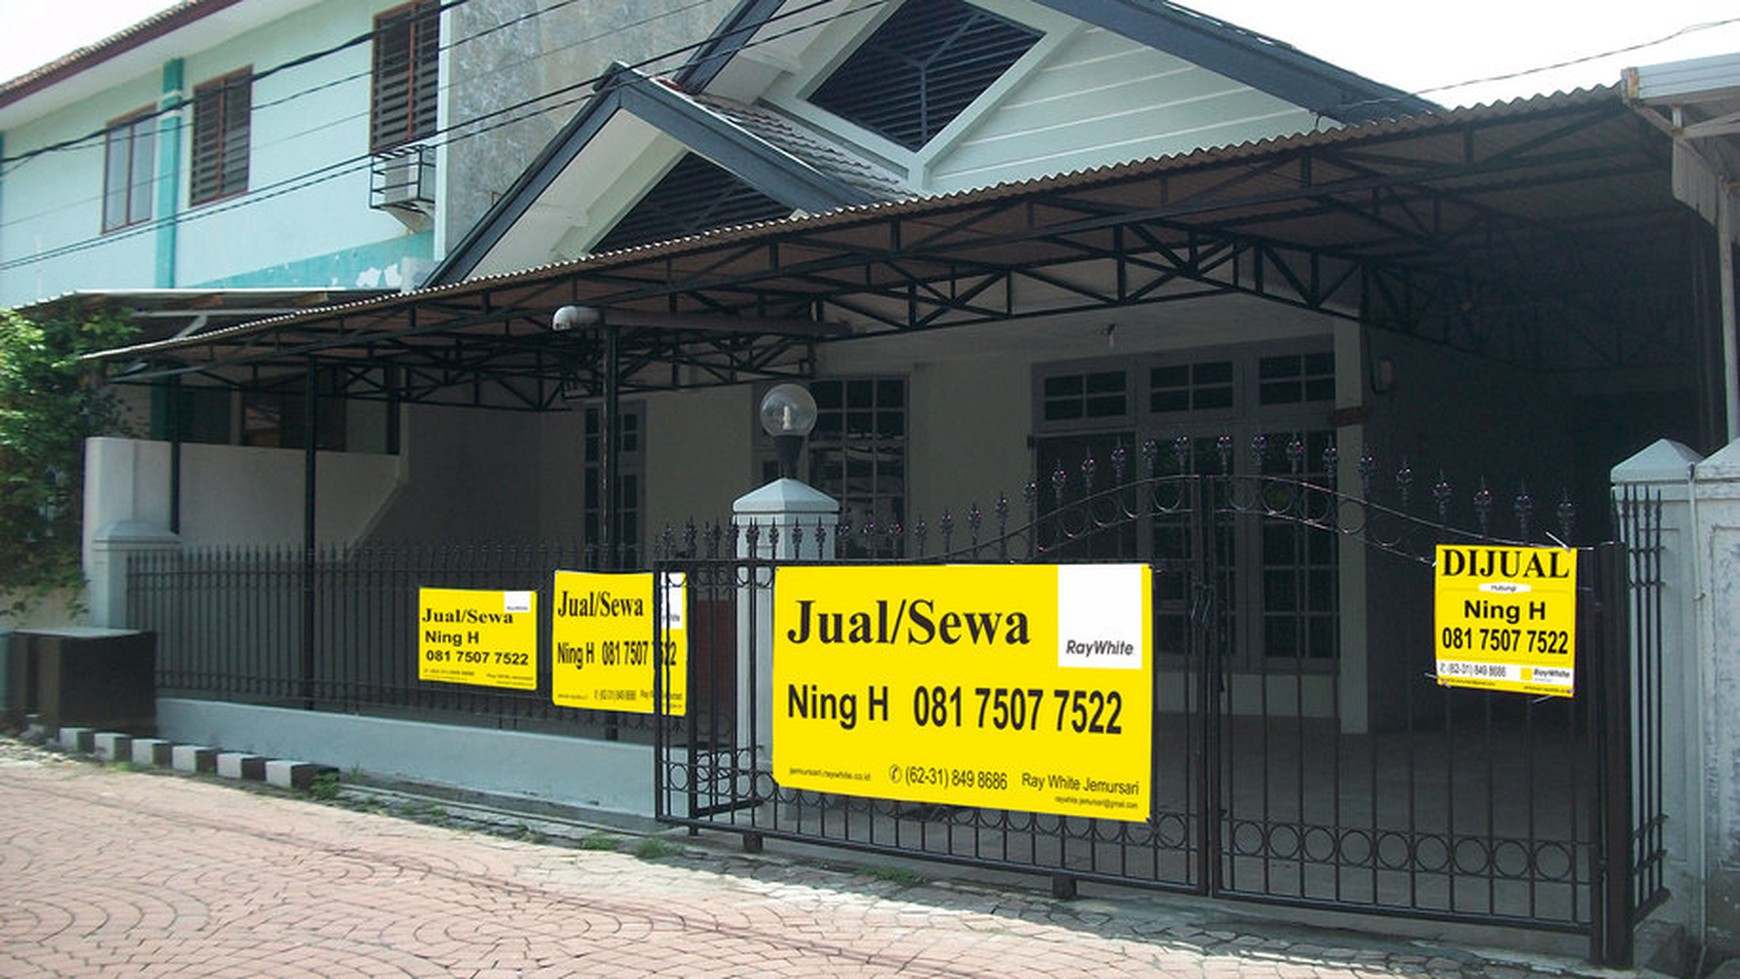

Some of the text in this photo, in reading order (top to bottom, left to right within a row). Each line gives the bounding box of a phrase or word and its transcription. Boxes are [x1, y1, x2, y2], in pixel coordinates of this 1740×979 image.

[1442, 549, 1569, 578] DIJUAL
[422, 608, 514, 624] Jual/Sewa
[557, 590, 644, 618] Jual/Sewa
[1464, 600, 1545, 624] Ning H
[787, 599, 1031, 645] Jual/Sewa
[425, 630, 479, 647] Ning H
[1066, 640, 1134, 657] RayWhite
[1442, 627, 1568, 654] 081 7507 7522
[426, 650, 529, 666] 081 7507 7522
[557, 642, 583, 670] Ning
[586, 642, 595, 663] H
[601, 641, 620, 666] 081
[624, 641, 649, 666] 7507
[788, 684, 1122, 734] Ning H 081 7507 7522
[905, 766, 1139, 795] (62-31) 849 8686 Ray White Jemursari
